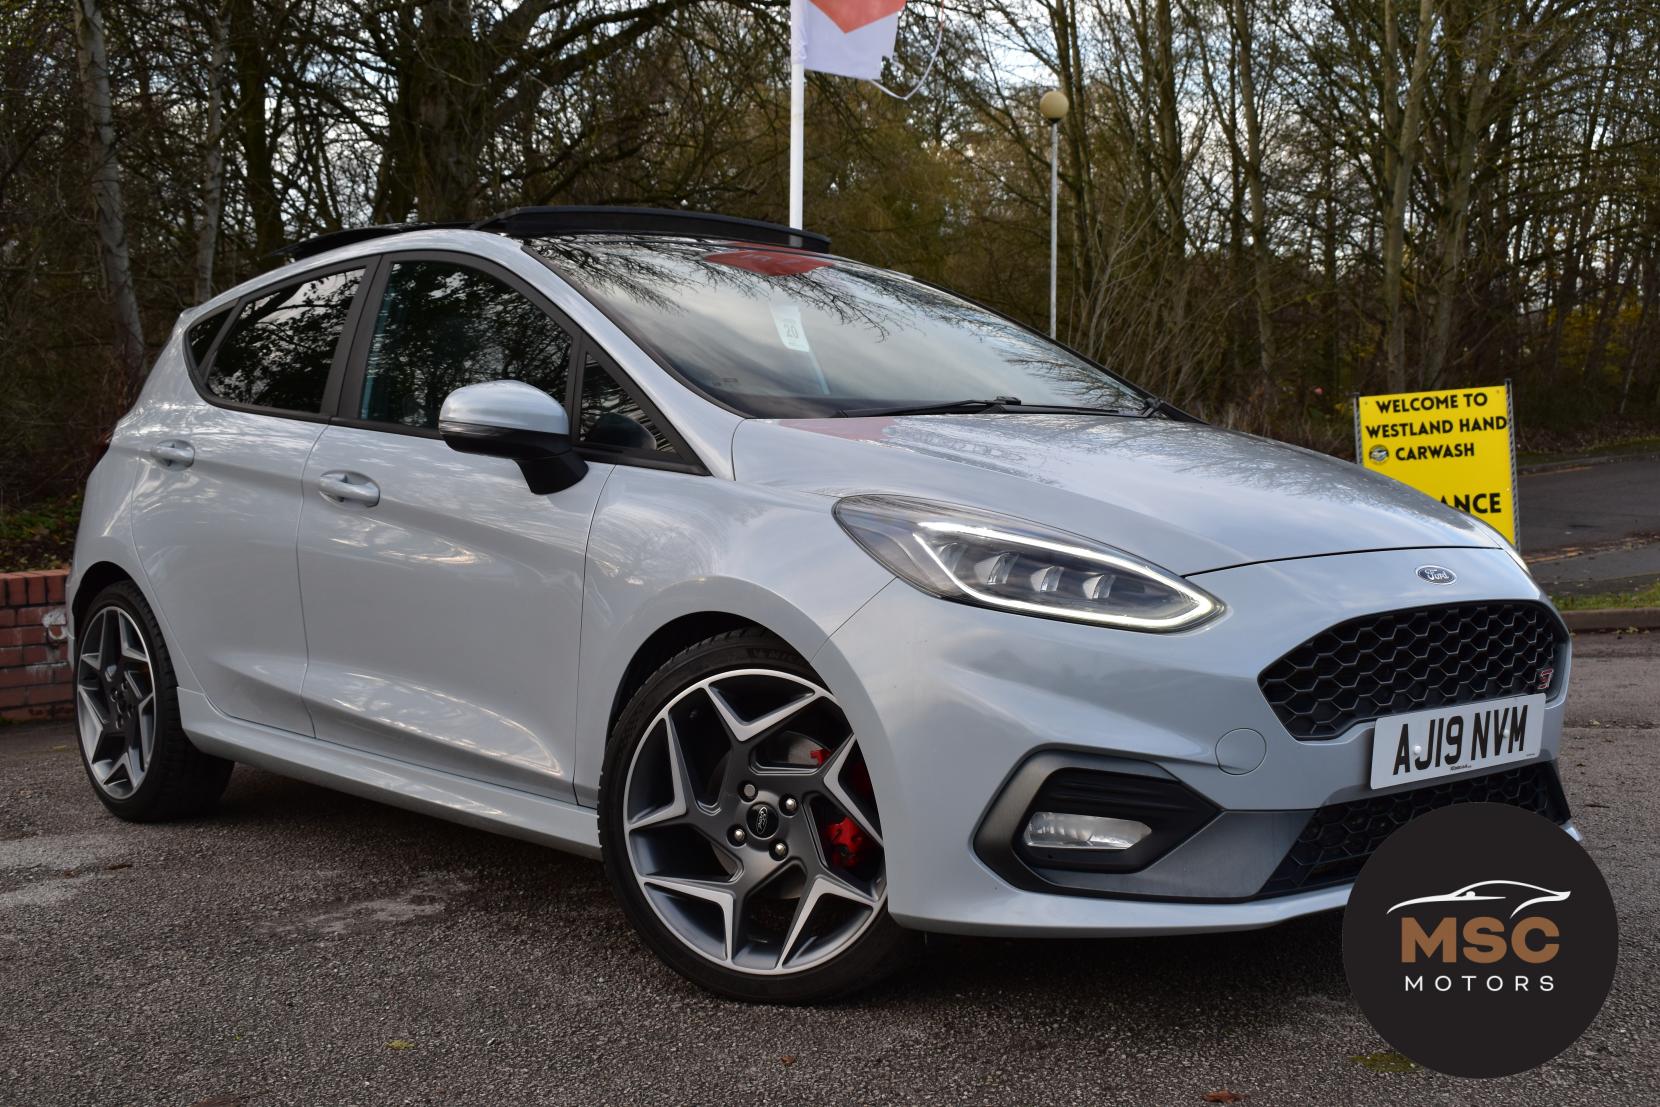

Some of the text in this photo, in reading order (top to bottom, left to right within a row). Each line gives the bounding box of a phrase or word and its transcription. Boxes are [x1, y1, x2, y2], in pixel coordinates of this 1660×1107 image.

[1376, 393, 1488, 414] WELCOME TO
[1366, 416, 1507, 439] WESTLAND HAND
[1395, 443, 1475, 461] CARWASH
[1393, 705, 1529, 776] AJ19 NVM
